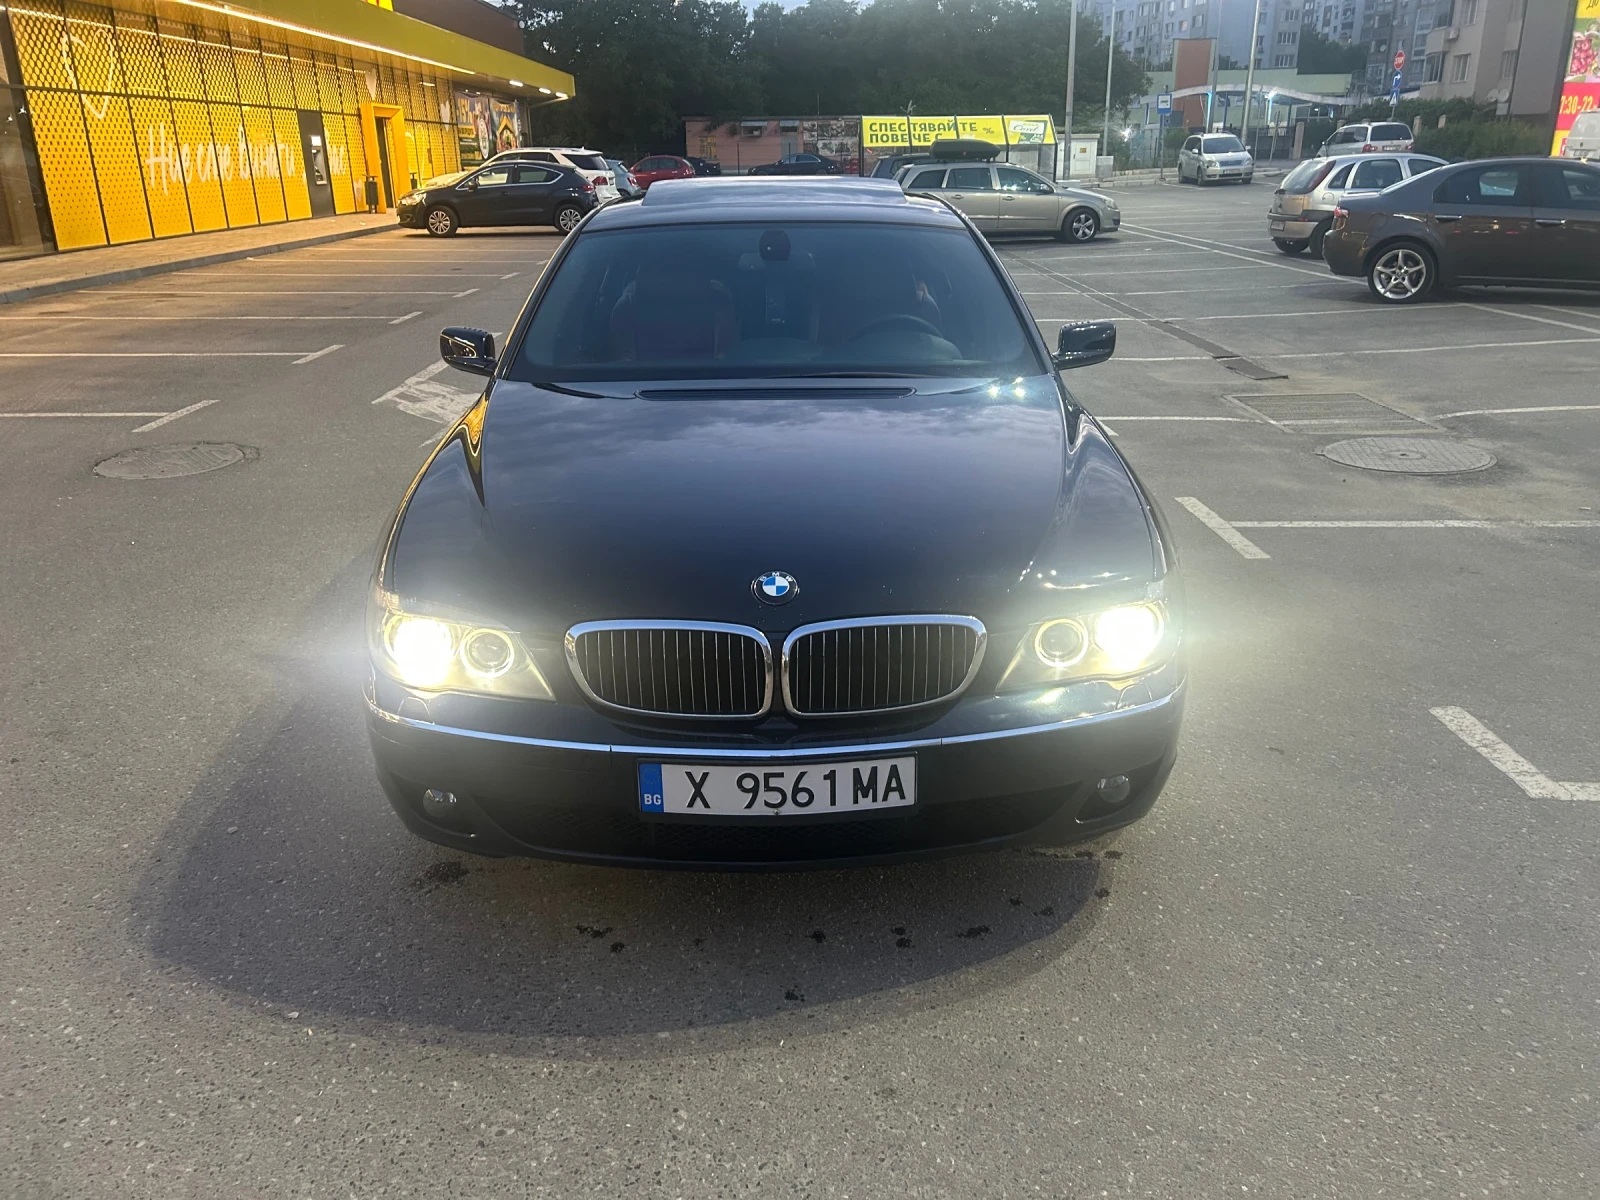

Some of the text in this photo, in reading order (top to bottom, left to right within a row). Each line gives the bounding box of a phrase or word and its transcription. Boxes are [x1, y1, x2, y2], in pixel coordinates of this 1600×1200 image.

[869, 133, 931, 144] ПОВЕЧЕ
[146, 121, 195, 196] Ние
[759, 571, 794, 582] BMW
[684, 764, 907, 809] X 9561 MA
[644, 793, 662, 806] BG
